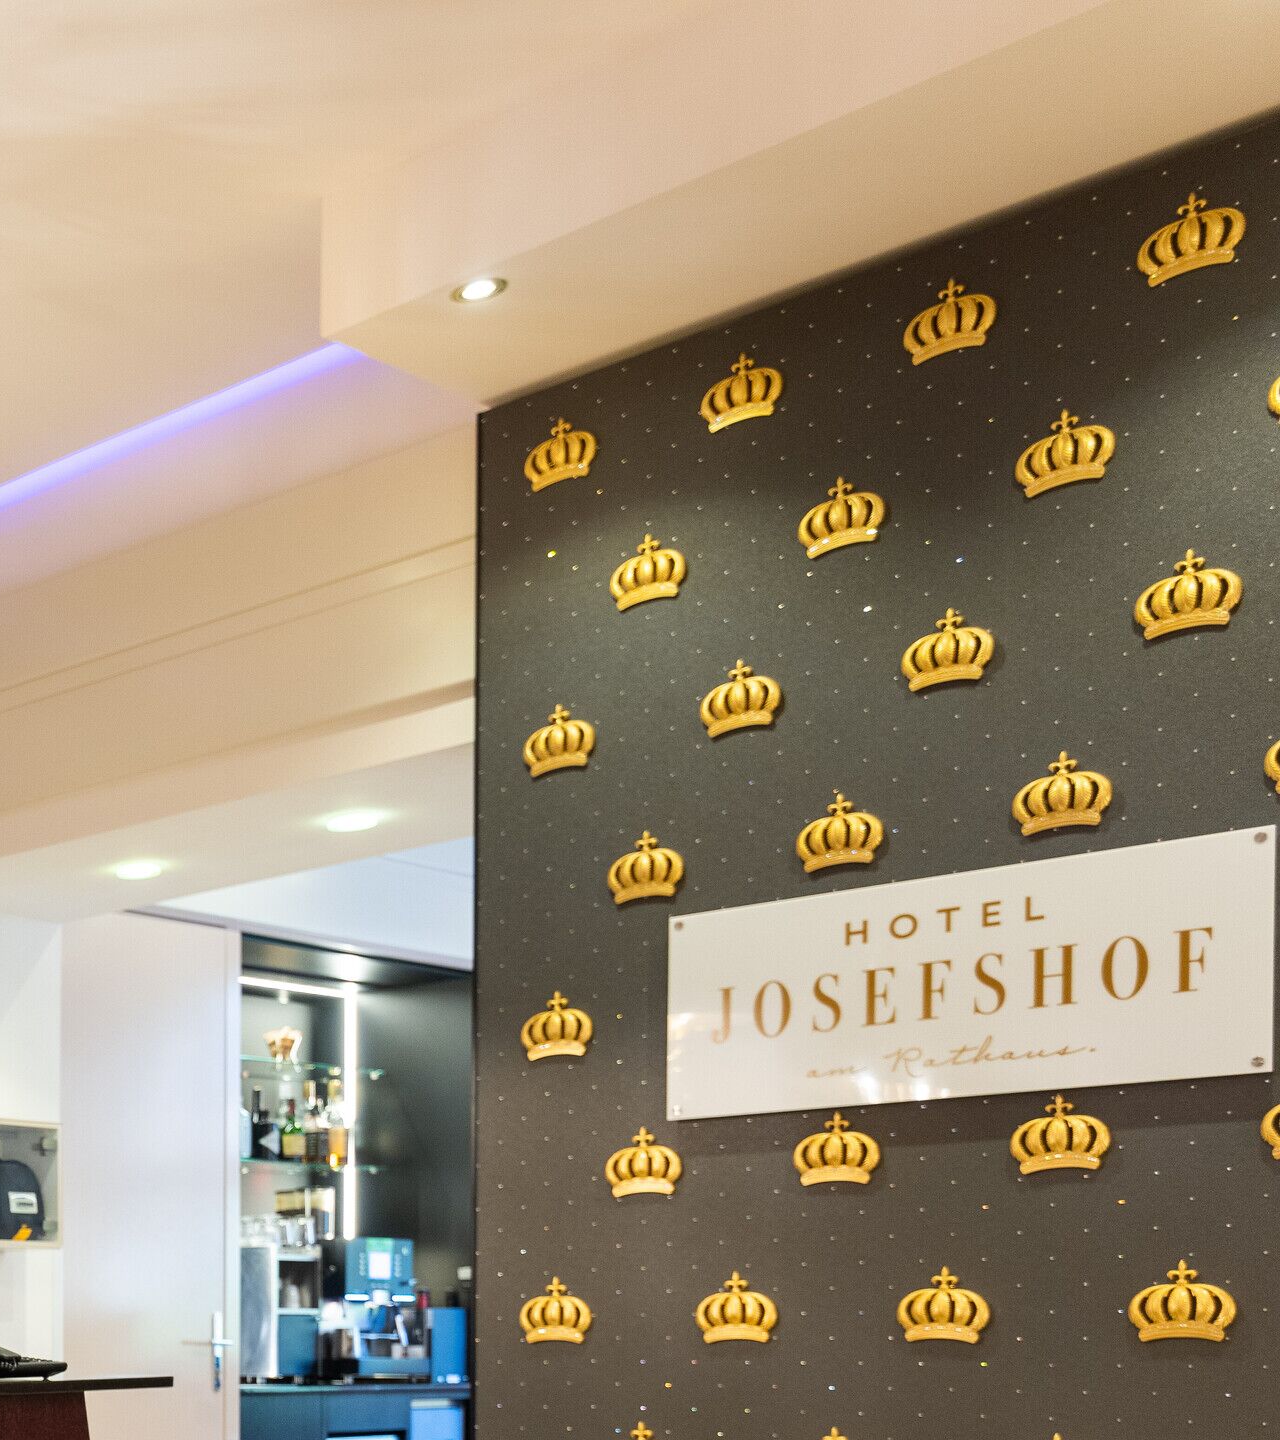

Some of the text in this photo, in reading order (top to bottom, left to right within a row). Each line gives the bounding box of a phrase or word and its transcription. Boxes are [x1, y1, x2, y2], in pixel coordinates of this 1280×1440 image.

[844, 896, 1046, 946] HOTEL
[710, 927, 1215, 1044] JOSEFSHOF
[806, 1064, 867, 1079] am
